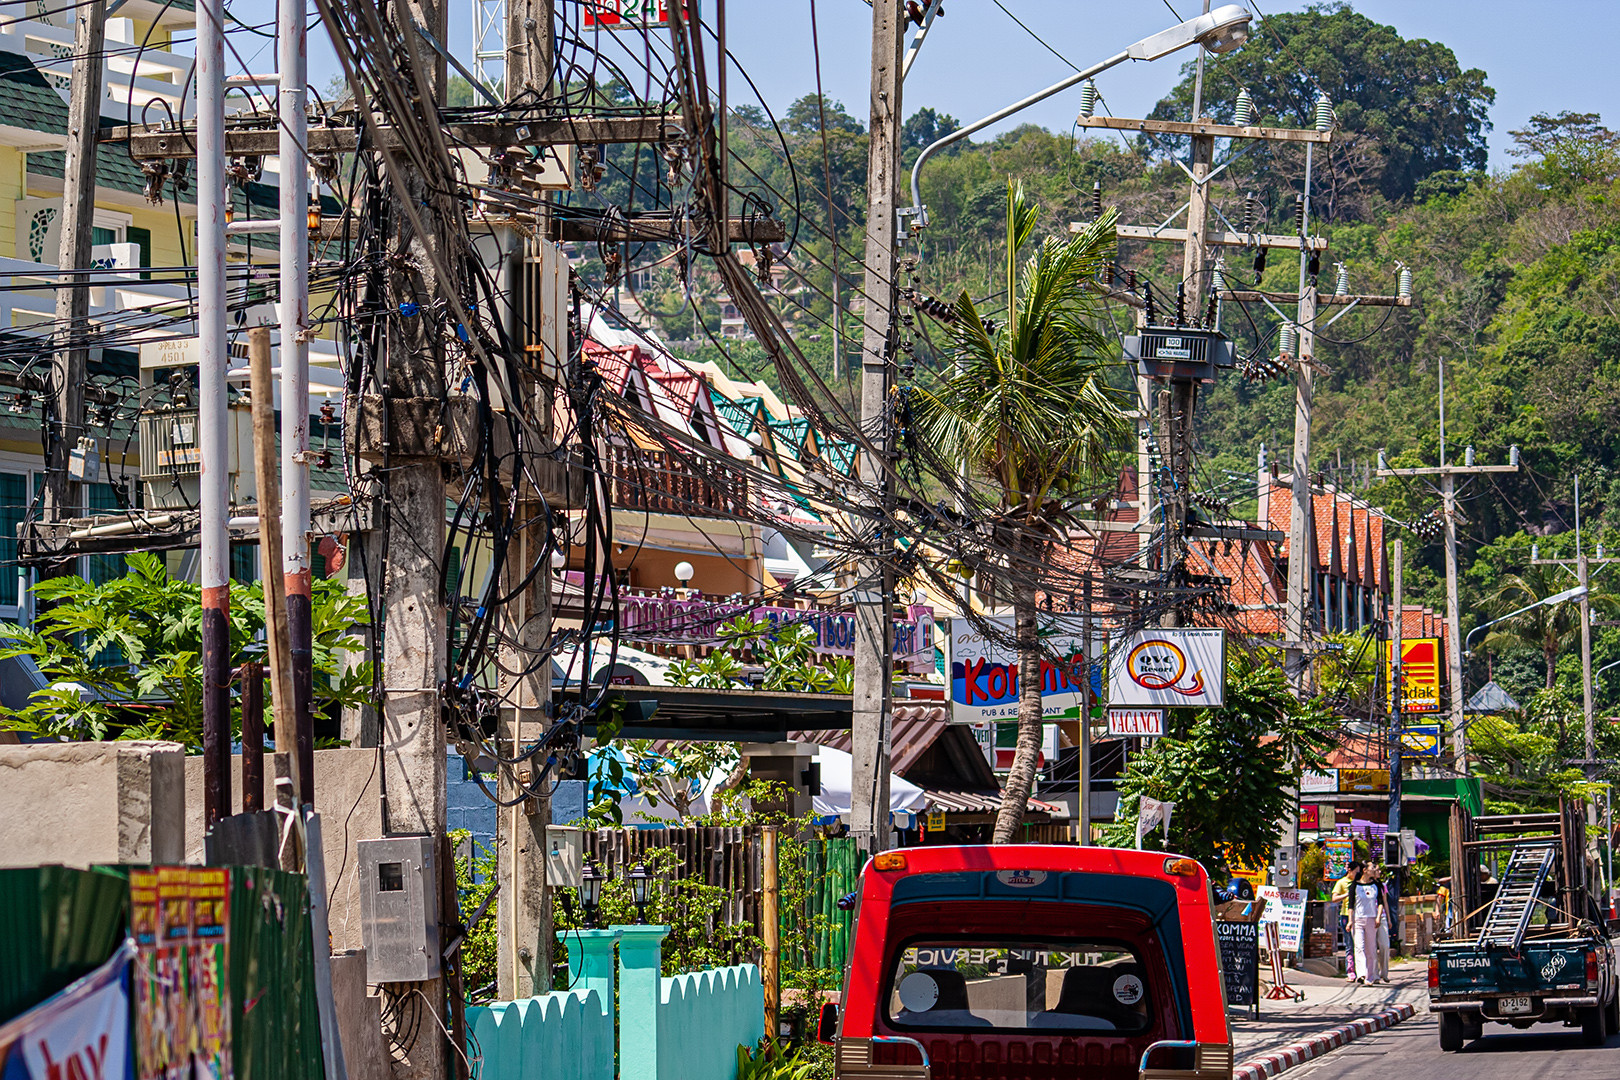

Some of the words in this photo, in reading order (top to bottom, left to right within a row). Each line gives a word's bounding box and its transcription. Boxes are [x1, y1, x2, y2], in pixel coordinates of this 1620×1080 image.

[1168, 338, 1181, 346] 100
[161, 352, 186, 362] 4501
[1140, 655, 1174, 665] QVC
[1000, 708, 1005, 716] &
[1110, 711, 1161, 733] VACANCY
[1264, 890, 1301, 901] MASSAGE
[1217, 923, 1256, 936] KOMMA
[1446, 957, 1491, 968] NISSAN
